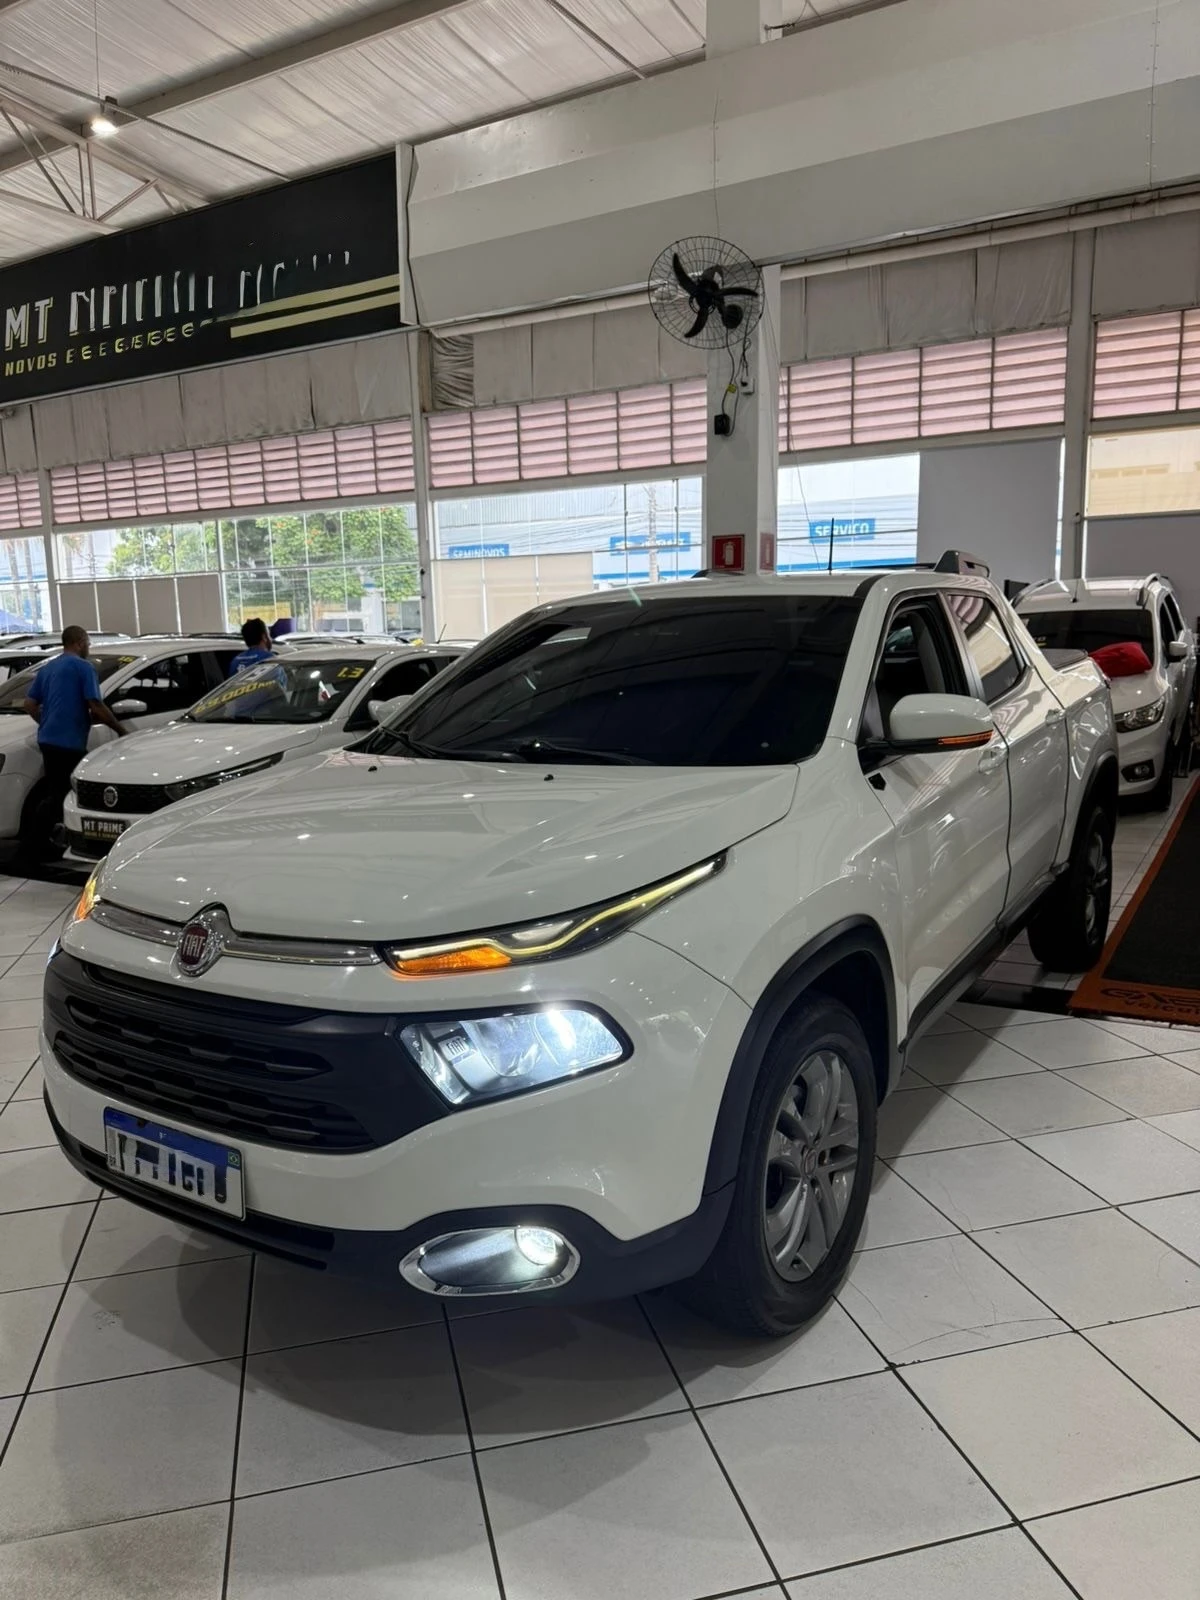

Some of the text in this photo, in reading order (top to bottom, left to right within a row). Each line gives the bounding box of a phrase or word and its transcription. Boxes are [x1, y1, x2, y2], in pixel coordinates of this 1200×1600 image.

[5, 297, 53, 351] MT
[5, 353, 57, 376] NOVOS
[84, 820, 124, 834] MT PRIME
[182, 934, 206, 957] FIAT
[446, 1037, 466, 1056] FIAT
